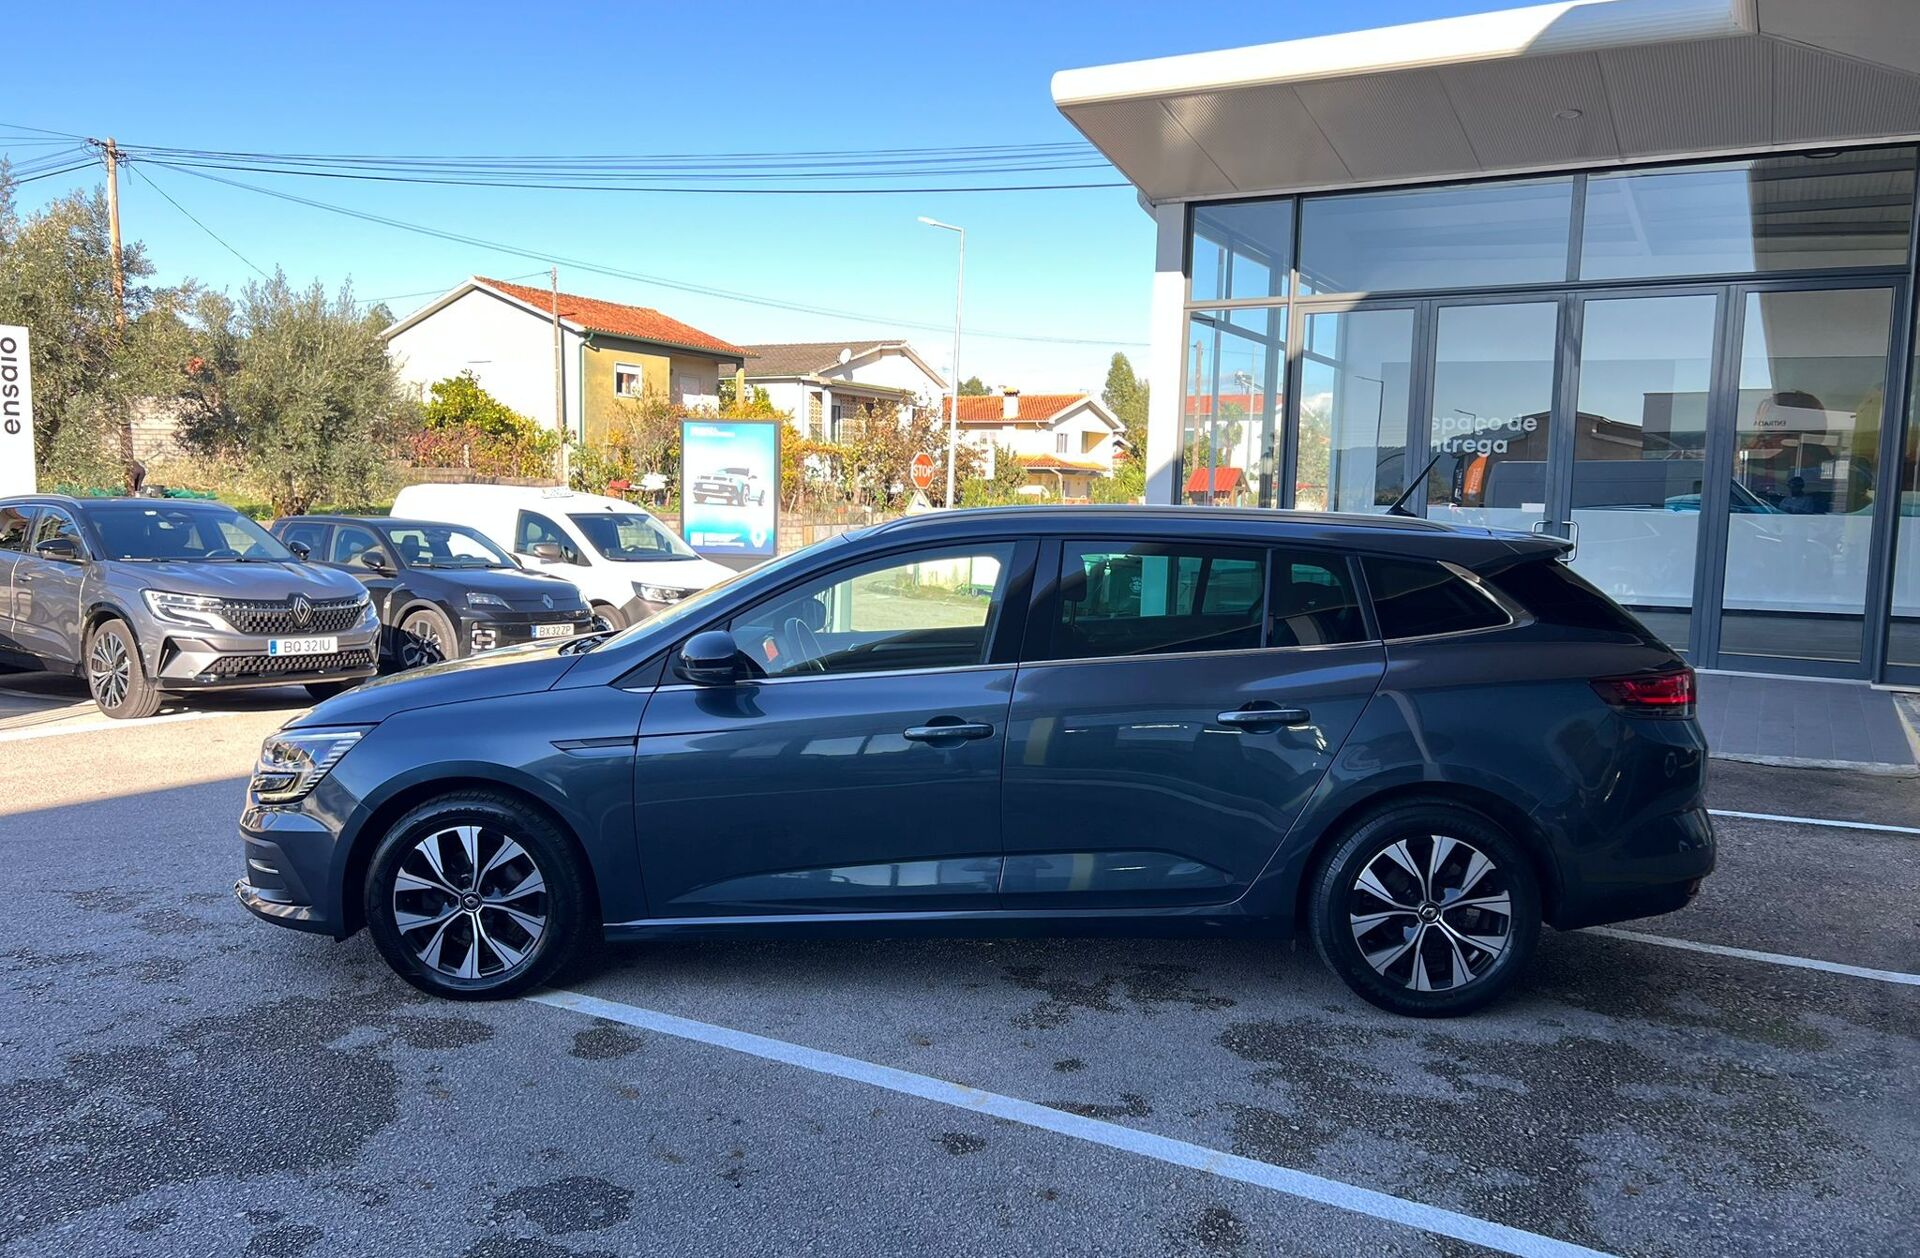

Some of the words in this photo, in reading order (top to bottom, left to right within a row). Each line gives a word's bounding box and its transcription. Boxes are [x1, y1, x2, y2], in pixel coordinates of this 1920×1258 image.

[0, 337, 21, 435] ensaio
[1431, 417, 1503, 436] spaço
[1507, 415, 1538, 432] de
[1430, 438, 1508, 458] ntrega
[913, 464, 933, 477] STOP
